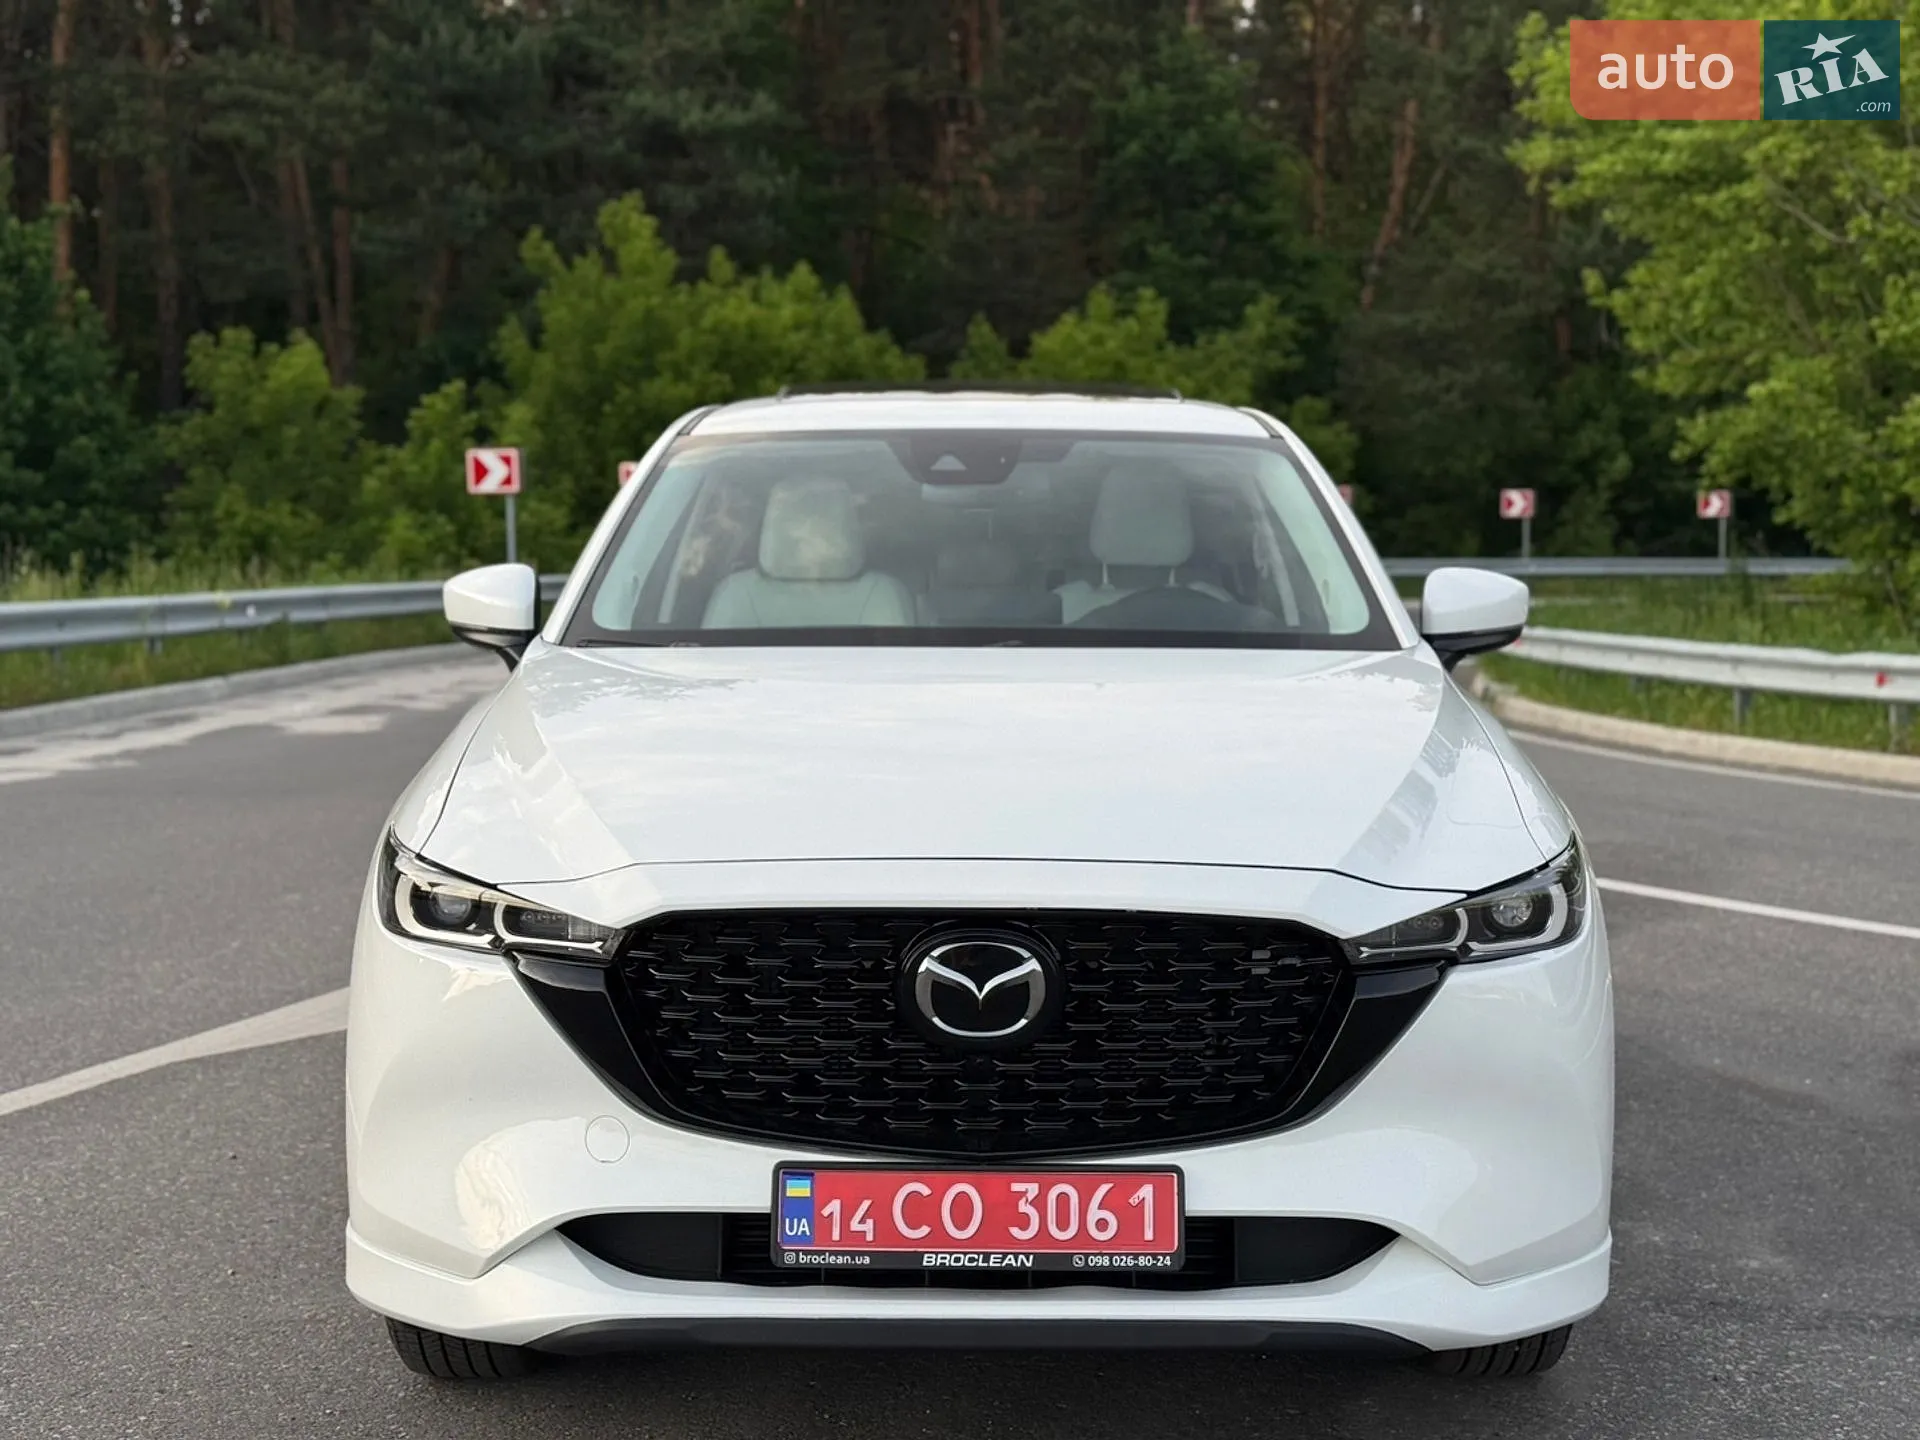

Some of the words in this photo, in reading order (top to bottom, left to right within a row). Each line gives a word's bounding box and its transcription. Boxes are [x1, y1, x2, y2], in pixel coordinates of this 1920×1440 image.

[820, 1198, 875, 1242] 14
[892, 1182, 984, 1241] CO
[1007, 1182, 1155, 1242] 3061
[785, 1218, 811, 1237] UA
[798, 1252, 871, 1265] broclean.ua
[922, 1253, 1034, 1268] BROCLEAN
[1087, 1255, 1110, 1267] 098
[1112, 1255, 1172, 1267] 026-80-24
